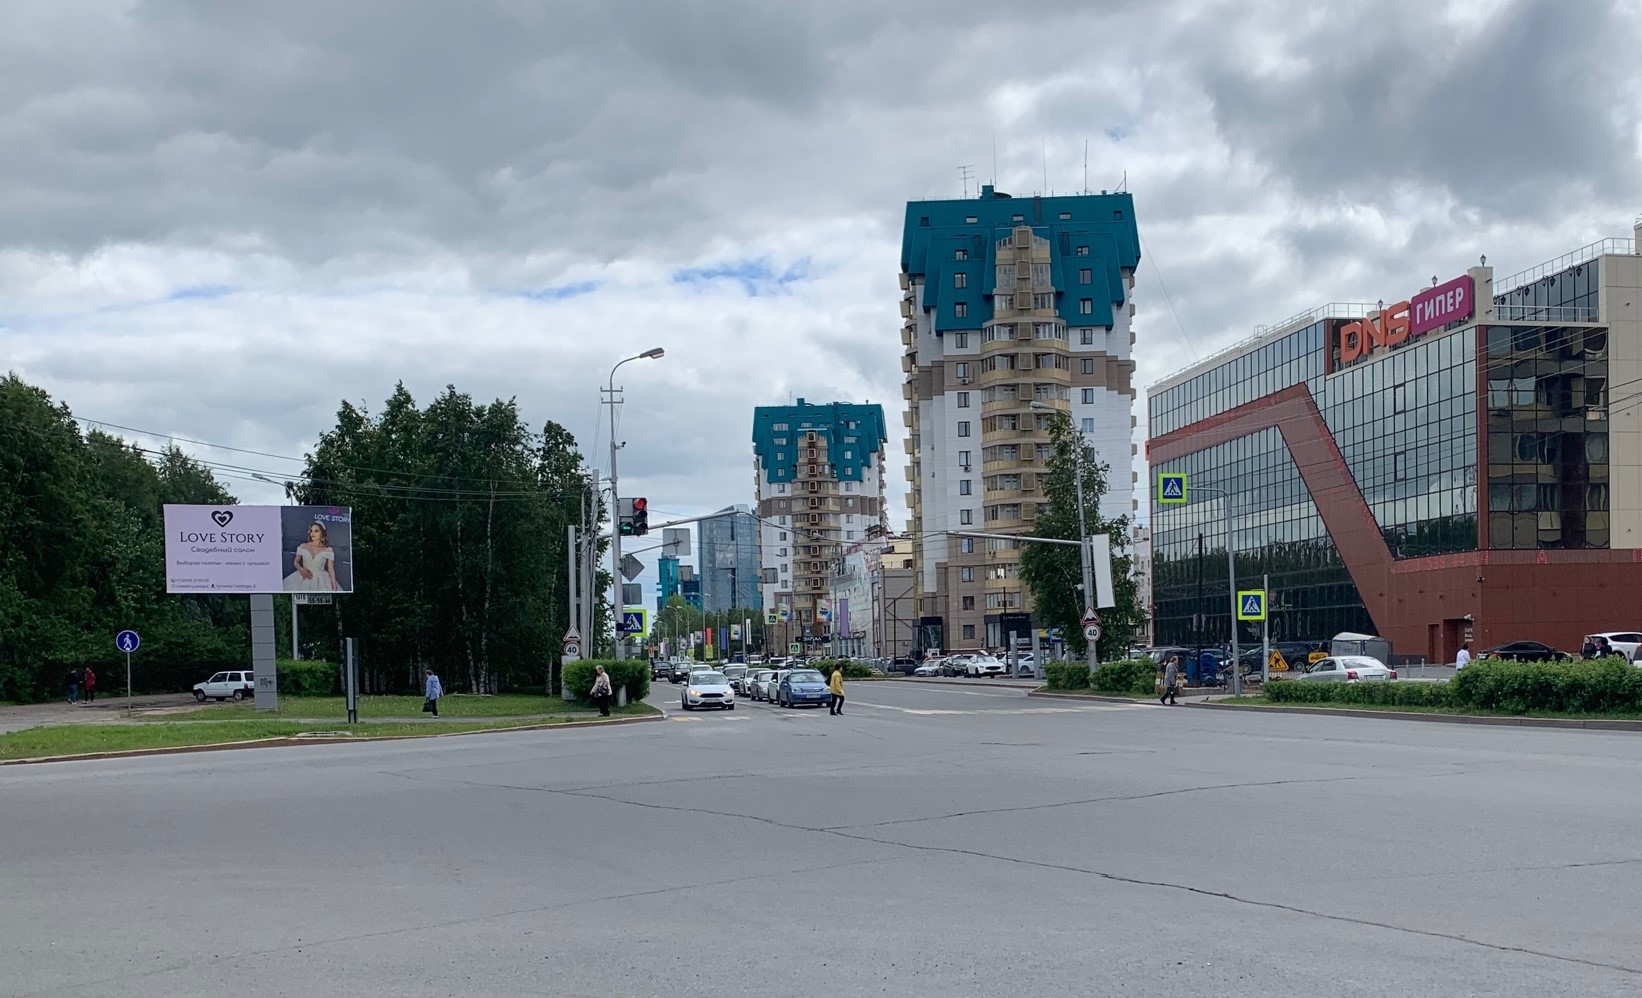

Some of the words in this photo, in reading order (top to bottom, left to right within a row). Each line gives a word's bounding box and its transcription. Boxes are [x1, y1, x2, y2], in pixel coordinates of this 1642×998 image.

[1415, 286, 1464, 325] ГИПЕР
[1340, 300, 1411, 363] DNS
[314, 513, 330, 521] LOVE
[190, 546, 232, 554] Свадебный
